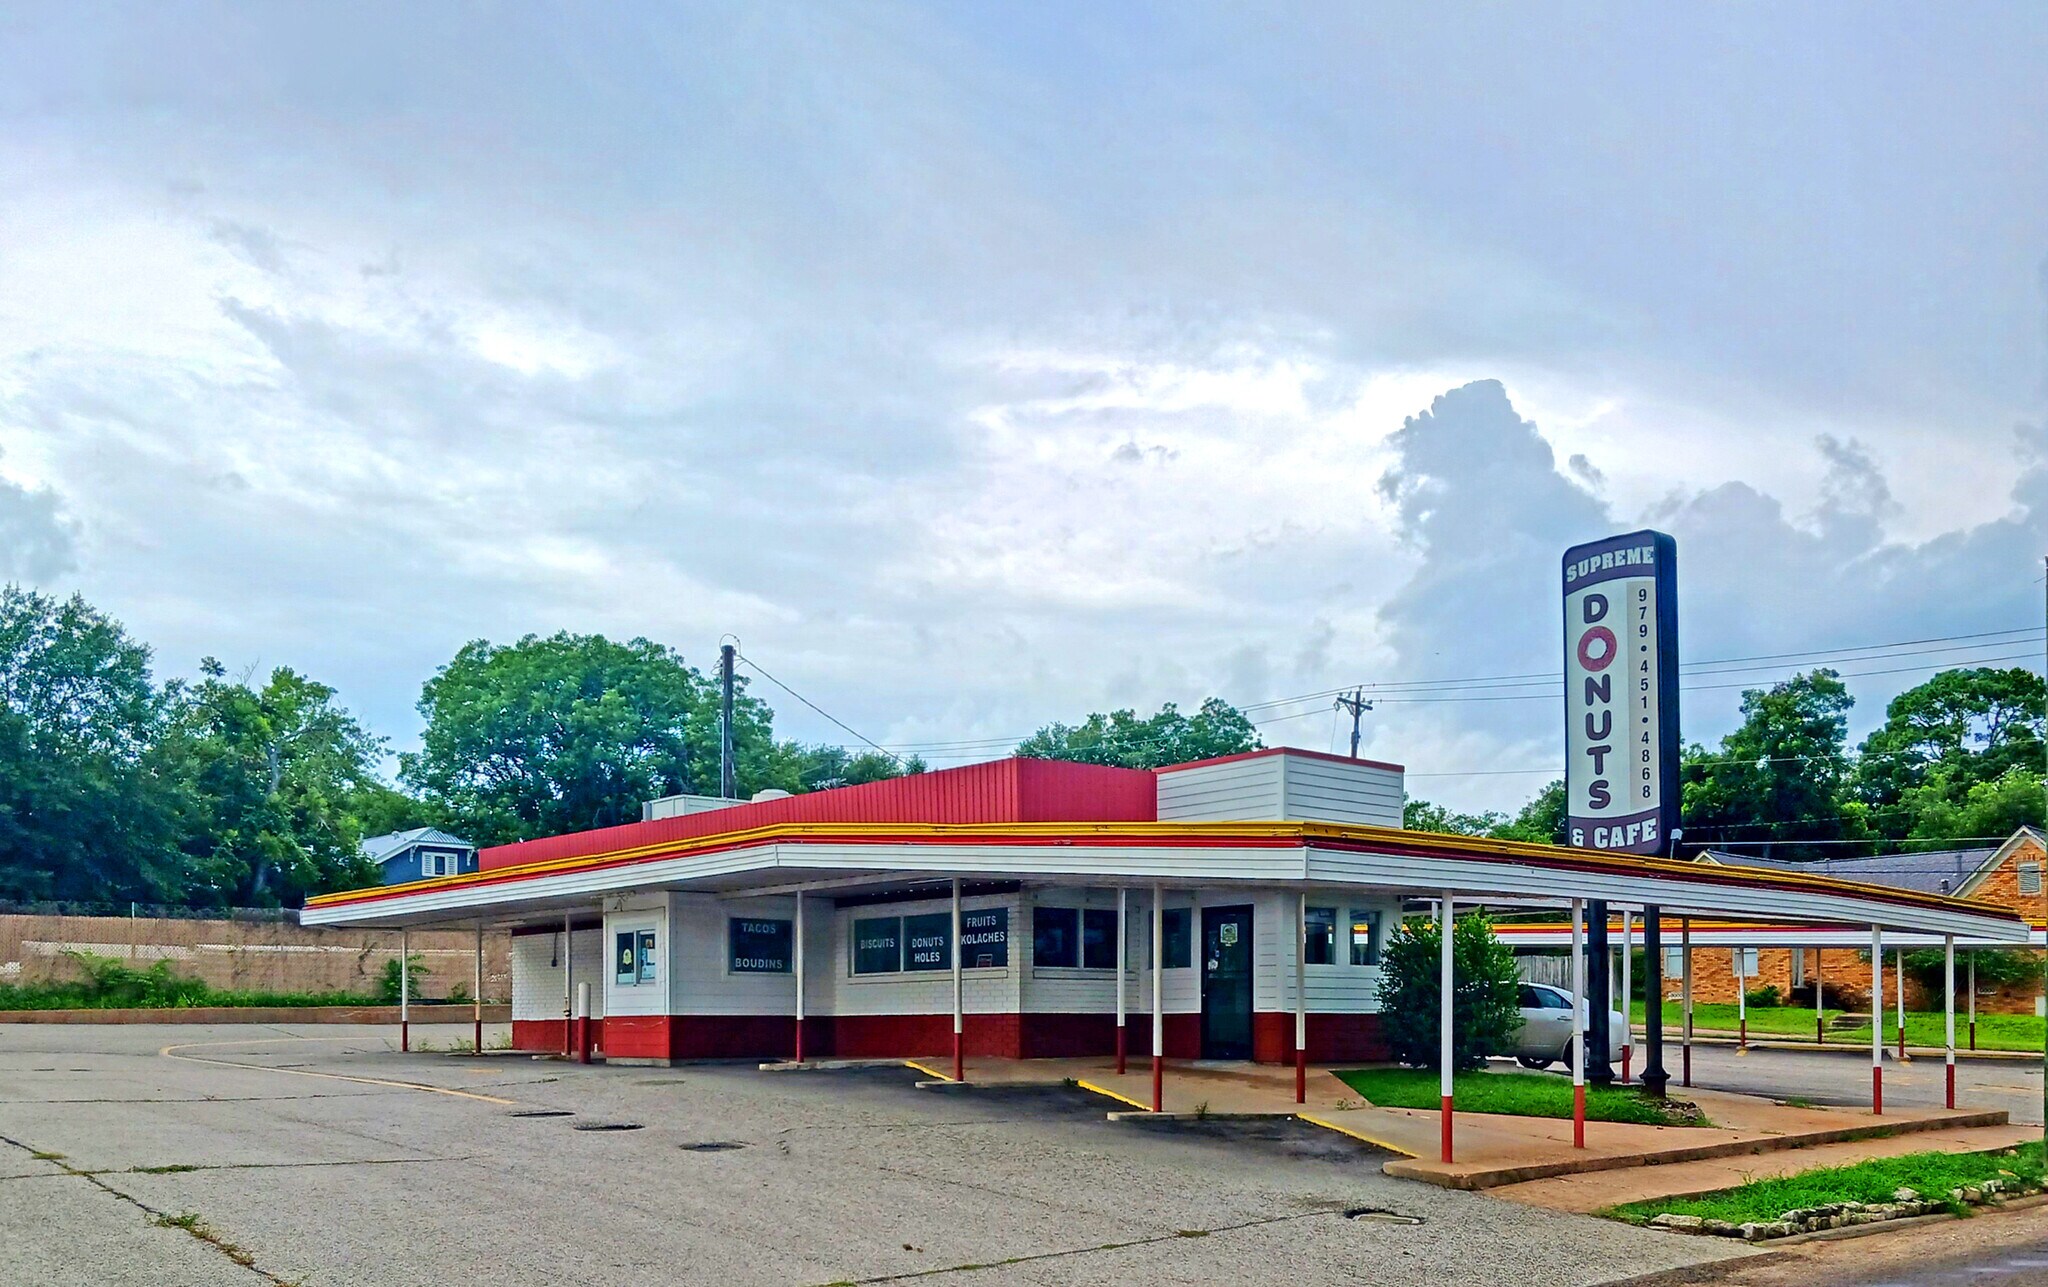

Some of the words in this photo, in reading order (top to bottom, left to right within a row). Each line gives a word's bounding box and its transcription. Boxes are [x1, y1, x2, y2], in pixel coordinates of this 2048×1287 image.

[1566, 546, 1654, 583] SUPREME
[1577, 593, 1618, 810] DONUTS
[1572, 828, 1584, 847] &
[1594, 818, 1657, 849] CAFE
[966, 915, 997, 928] FRUITS
[741, 922, 777, 934] TACOS
[860, 938, 895, 950] BISCUITS
[912, 936, 944, 948] DONUTS
[961, 931, 1005, 945] KOLACHES
[735, 957, 783, 969] BOUDINS
[914, 952, 941, 963] HOLES
